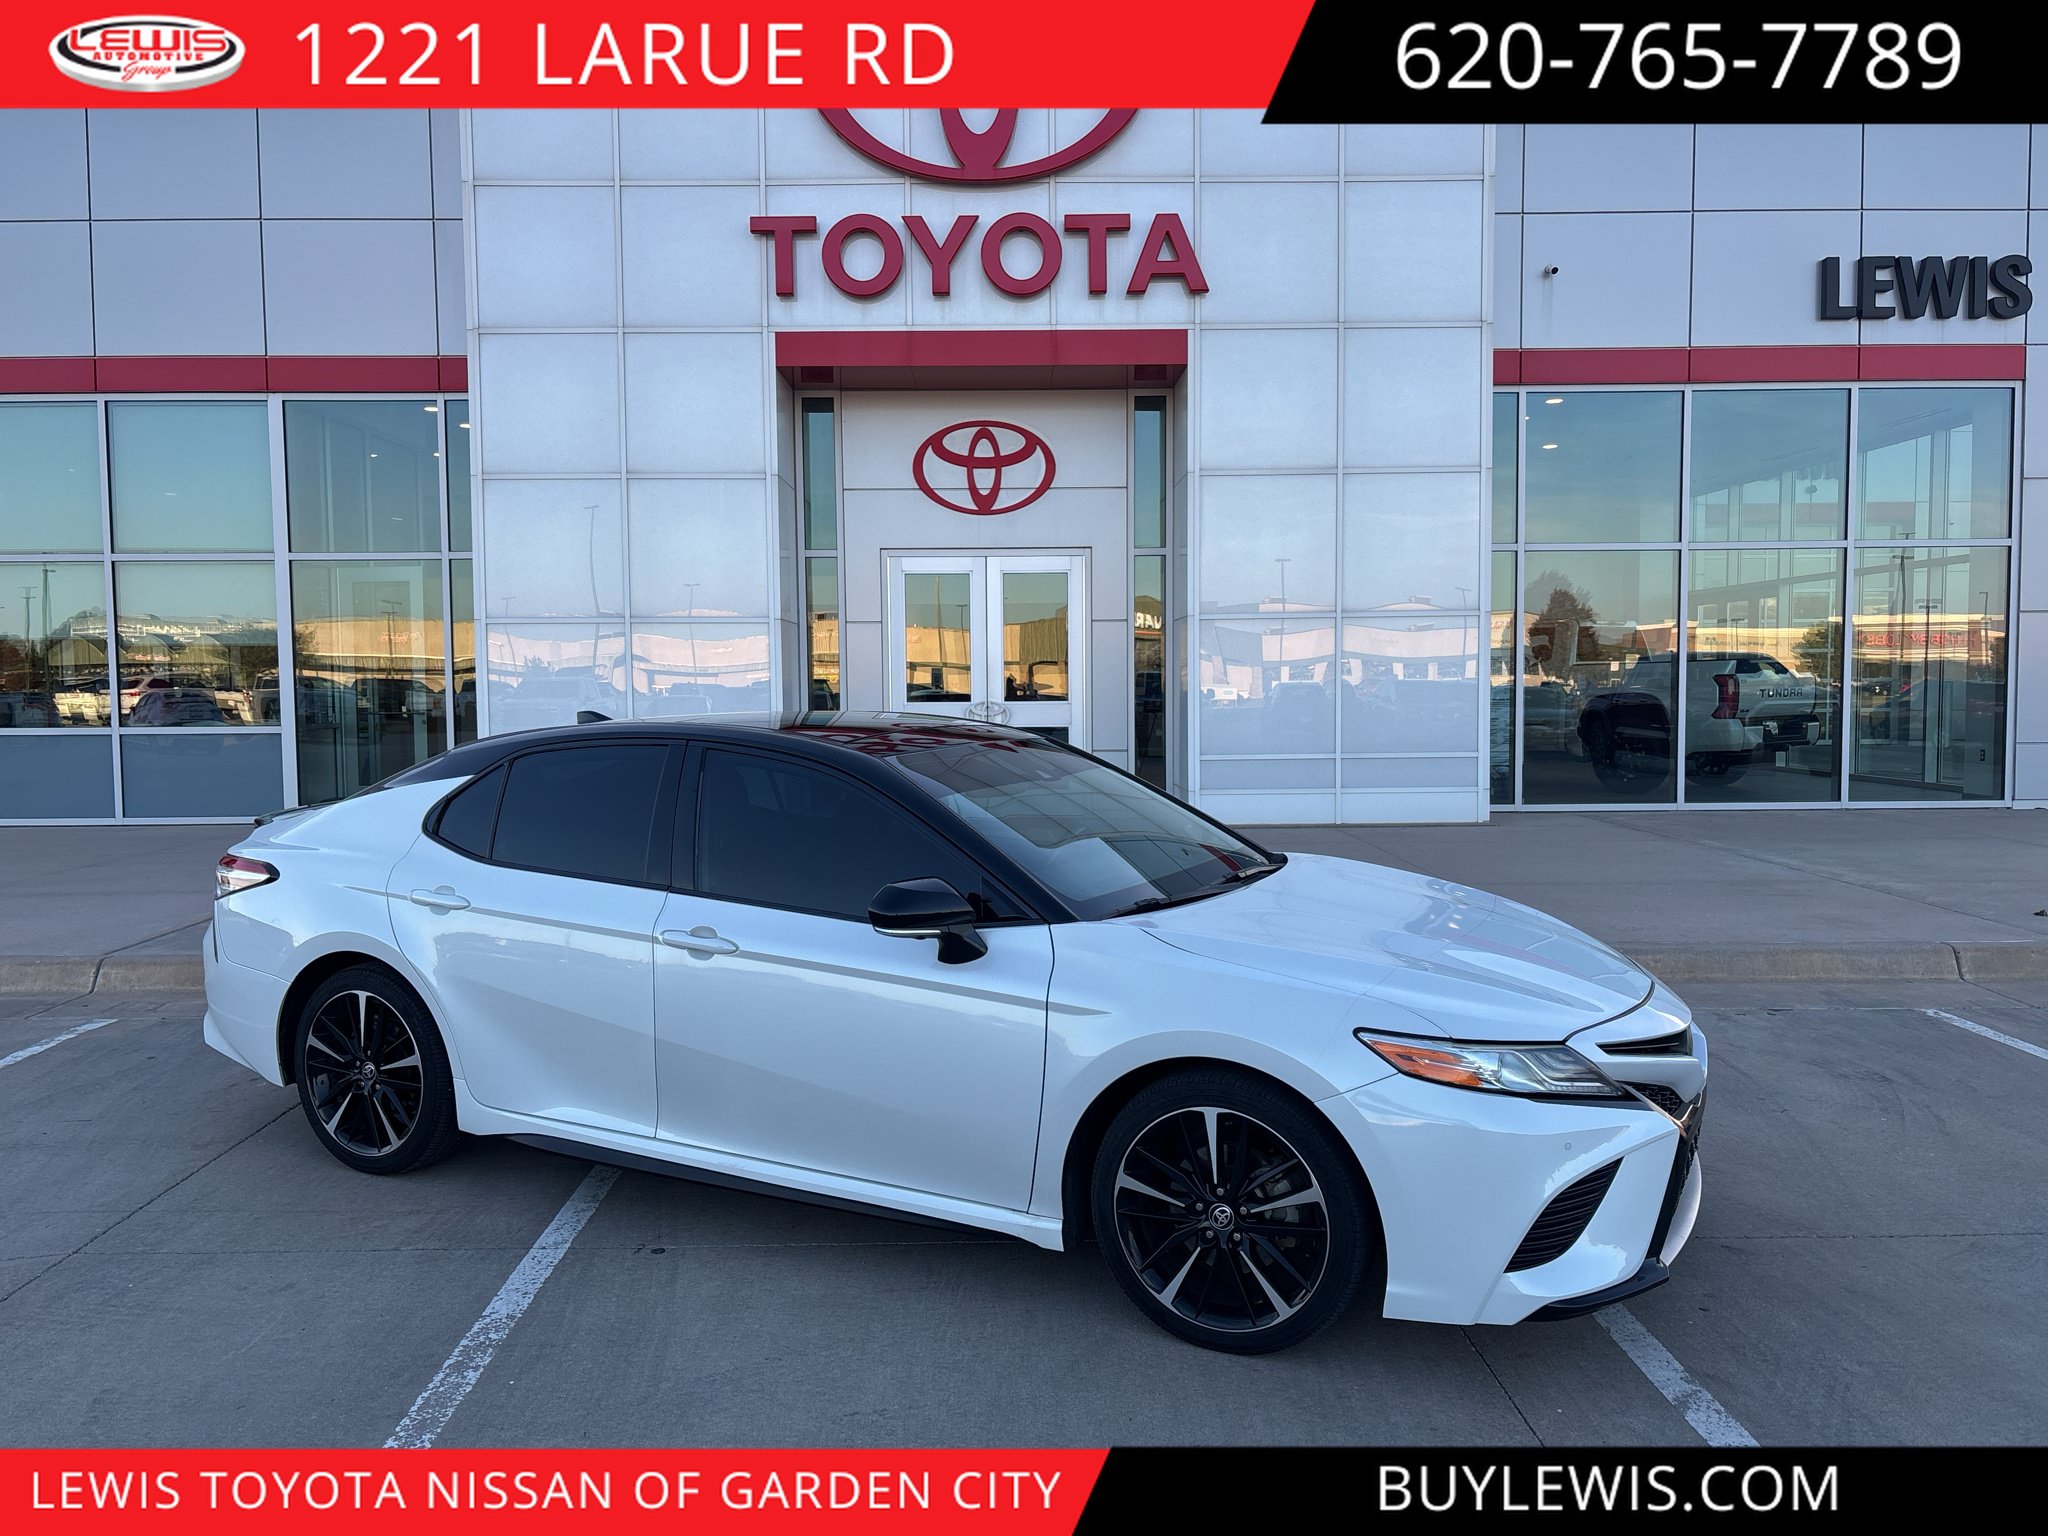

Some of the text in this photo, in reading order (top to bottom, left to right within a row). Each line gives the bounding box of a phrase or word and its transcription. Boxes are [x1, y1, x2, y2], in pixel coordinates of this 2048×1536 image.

[749, 211, 1210, 298] TOYOTA
[1819, 254, 2034, 320] LEWIS
[1759, 688, 1803, 698] TUNDRA
